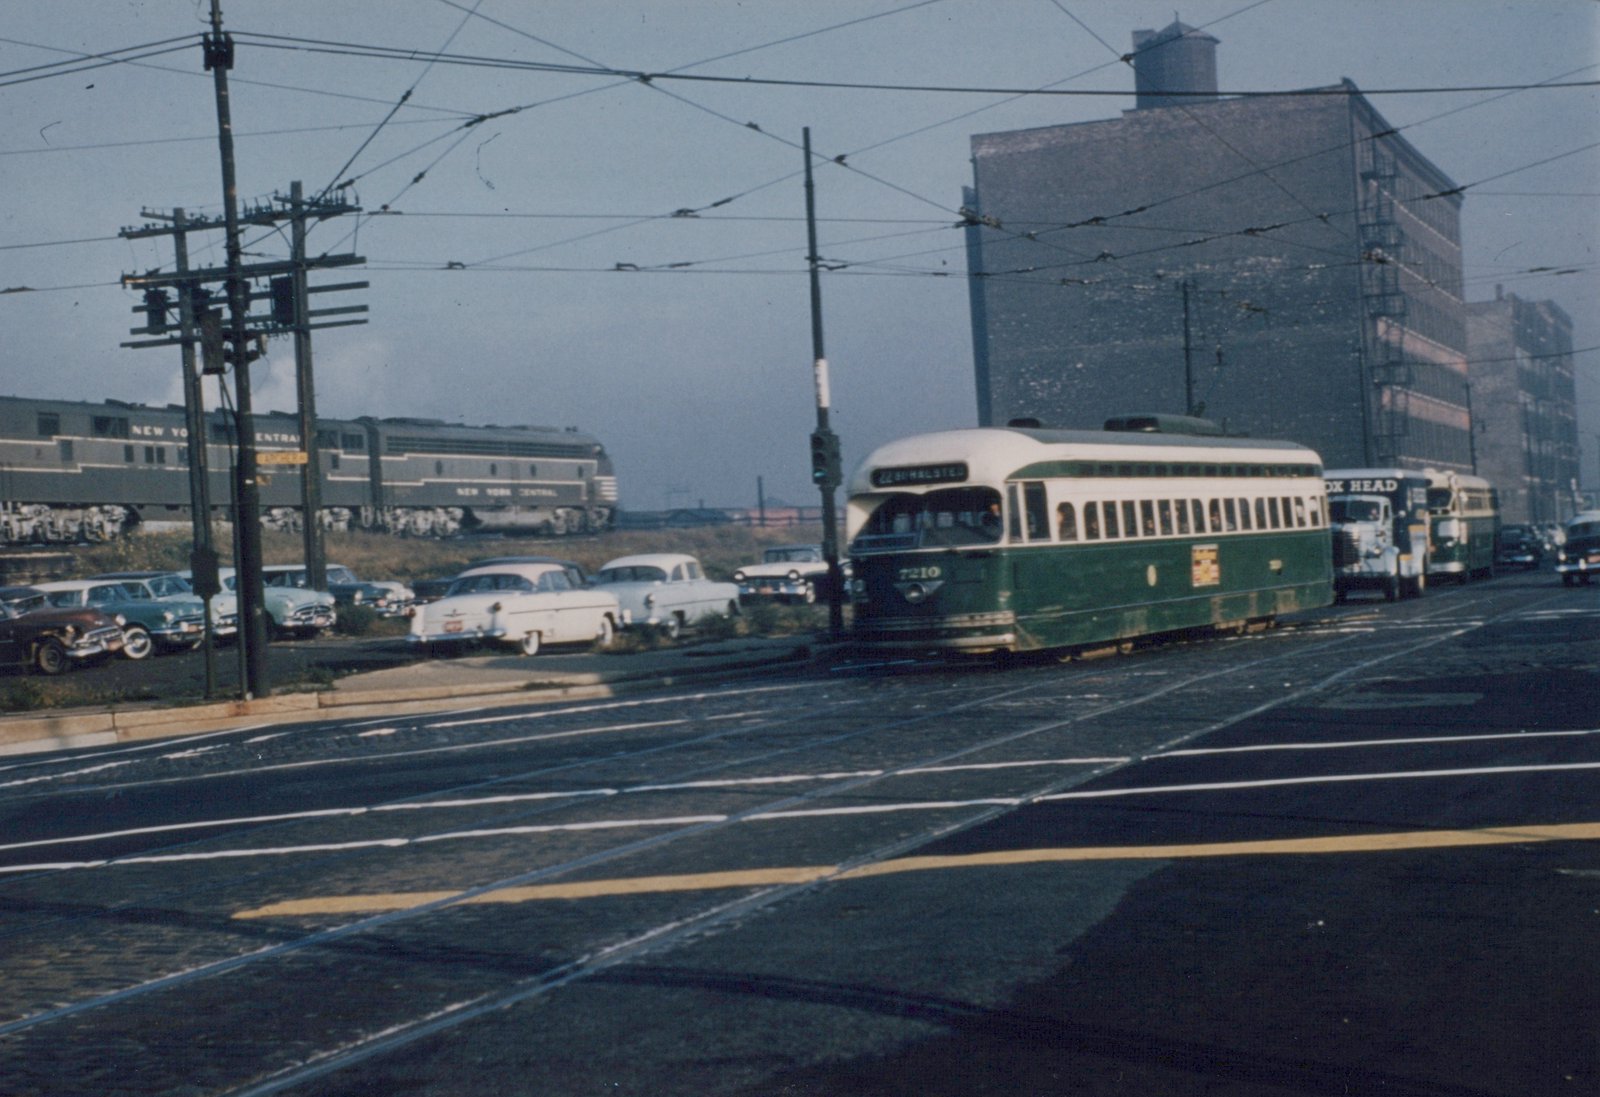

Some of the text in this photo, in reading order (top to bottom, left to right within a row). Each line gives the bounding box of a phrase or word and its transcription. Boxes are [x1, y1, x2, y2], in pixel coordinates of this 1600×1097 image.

[132, 425, 164, 437] NEW
[255, 432, 300, 443] ENTRA
[456, 488, 479, 496] NEW
[1326, 480, 1398, 492] OX HEAD
[899, 566, 941, 580] 7210
